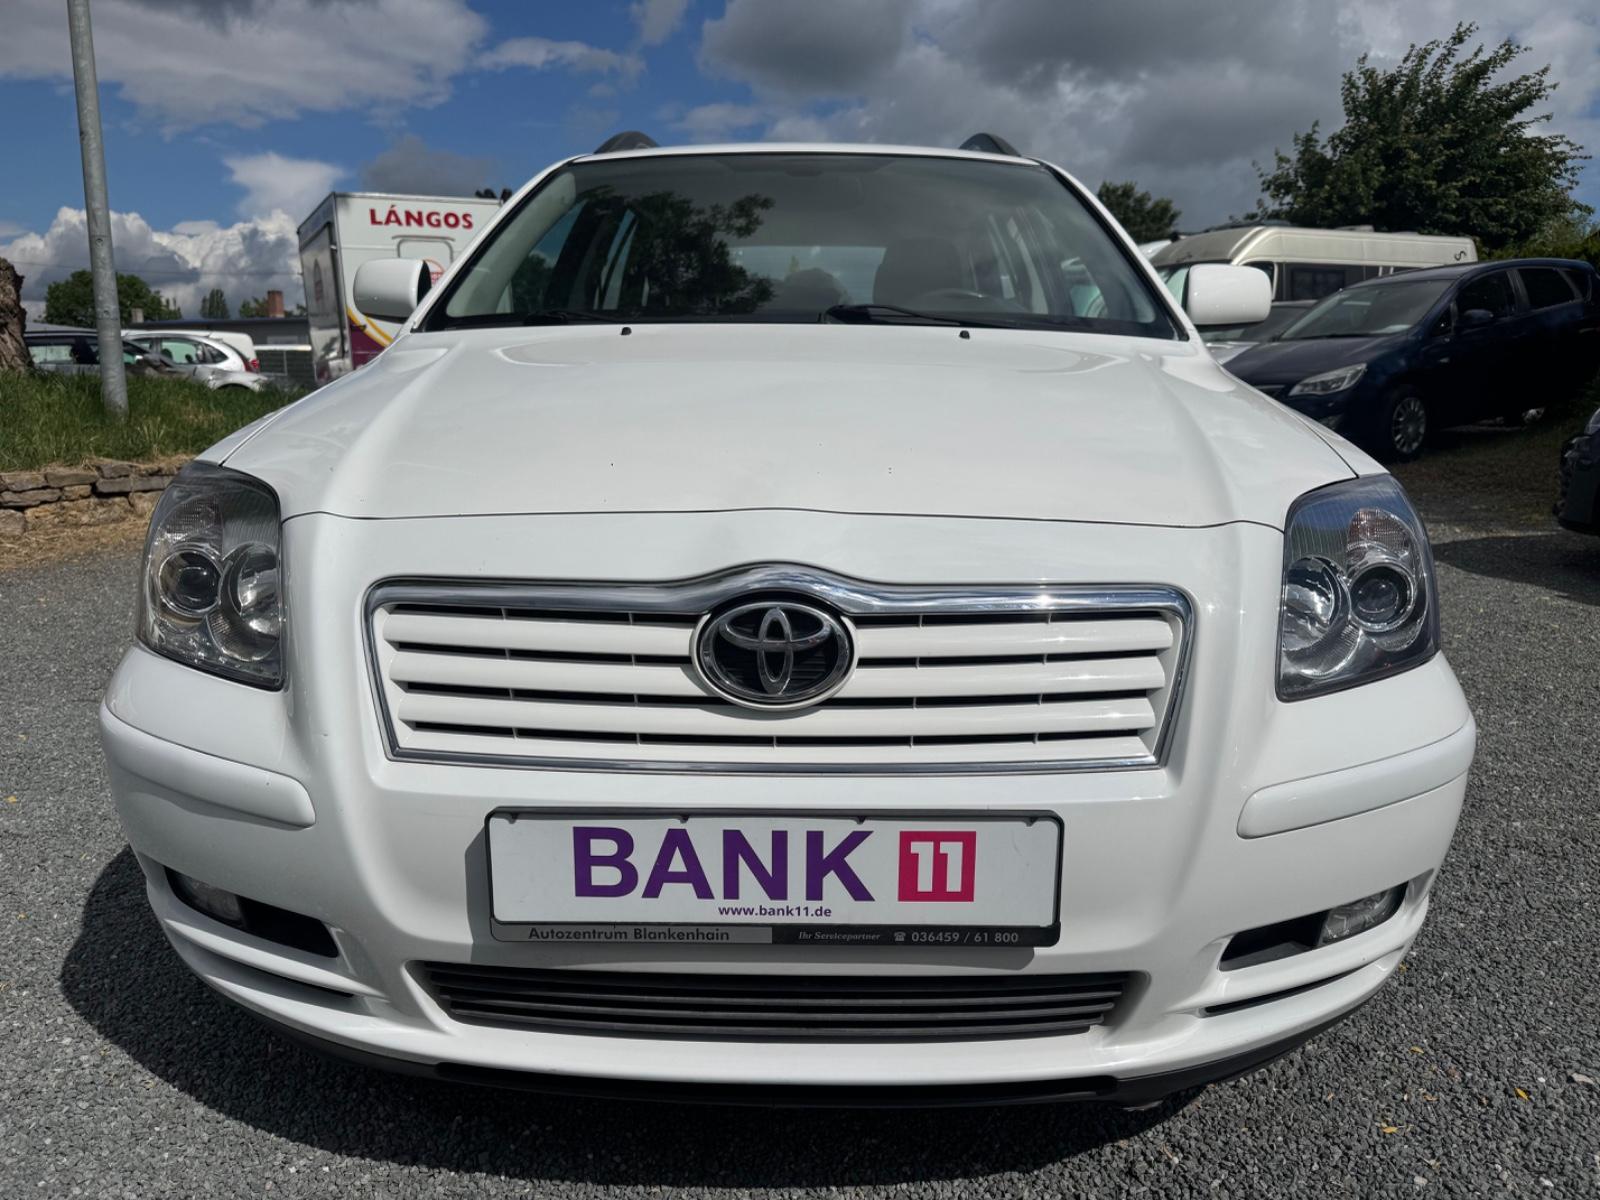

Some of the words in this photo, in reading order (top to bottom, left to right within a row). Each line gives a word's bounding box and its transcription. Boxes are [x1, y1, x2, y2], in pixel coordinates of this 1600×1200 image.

[369, 204, 473, 229] LÁNGOS
[573, 826, 876, 902] BANK
[910, 841, 963, 893] 11
[718, 905, 832, 918] www.bank11.de
[528, 927, 627, 941] Autozentrum
[634, 928, 730, 941] Blankenhain
[799, 931, 813, 941] Ihr
[814, 931, 881, 943] Servicepartner
[911, 931, 960, 943] 036459
[974, 931, 990, 943] 61
[994, 931, 1019, 943] 800
